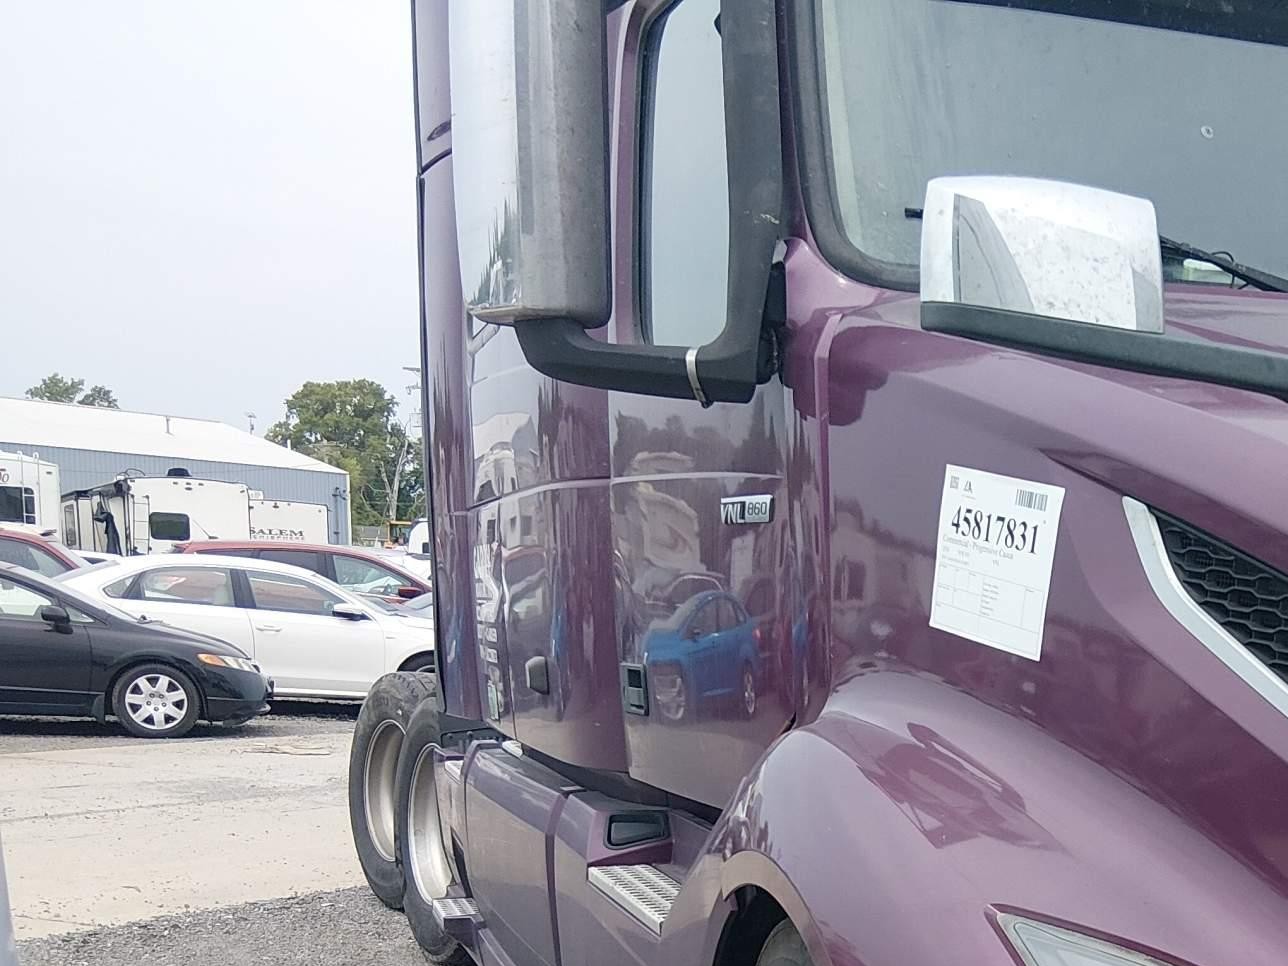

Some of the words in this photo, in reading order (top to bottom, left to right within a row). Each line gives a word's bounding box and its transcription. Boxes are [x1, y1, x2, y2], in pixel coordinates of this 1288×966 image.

[720, 503, 745, 525] VNL
[747, 501, 768, 516] 860
[250, 527, 304, 537] SALEM
[951, 505, 1039, 555] 45817831
